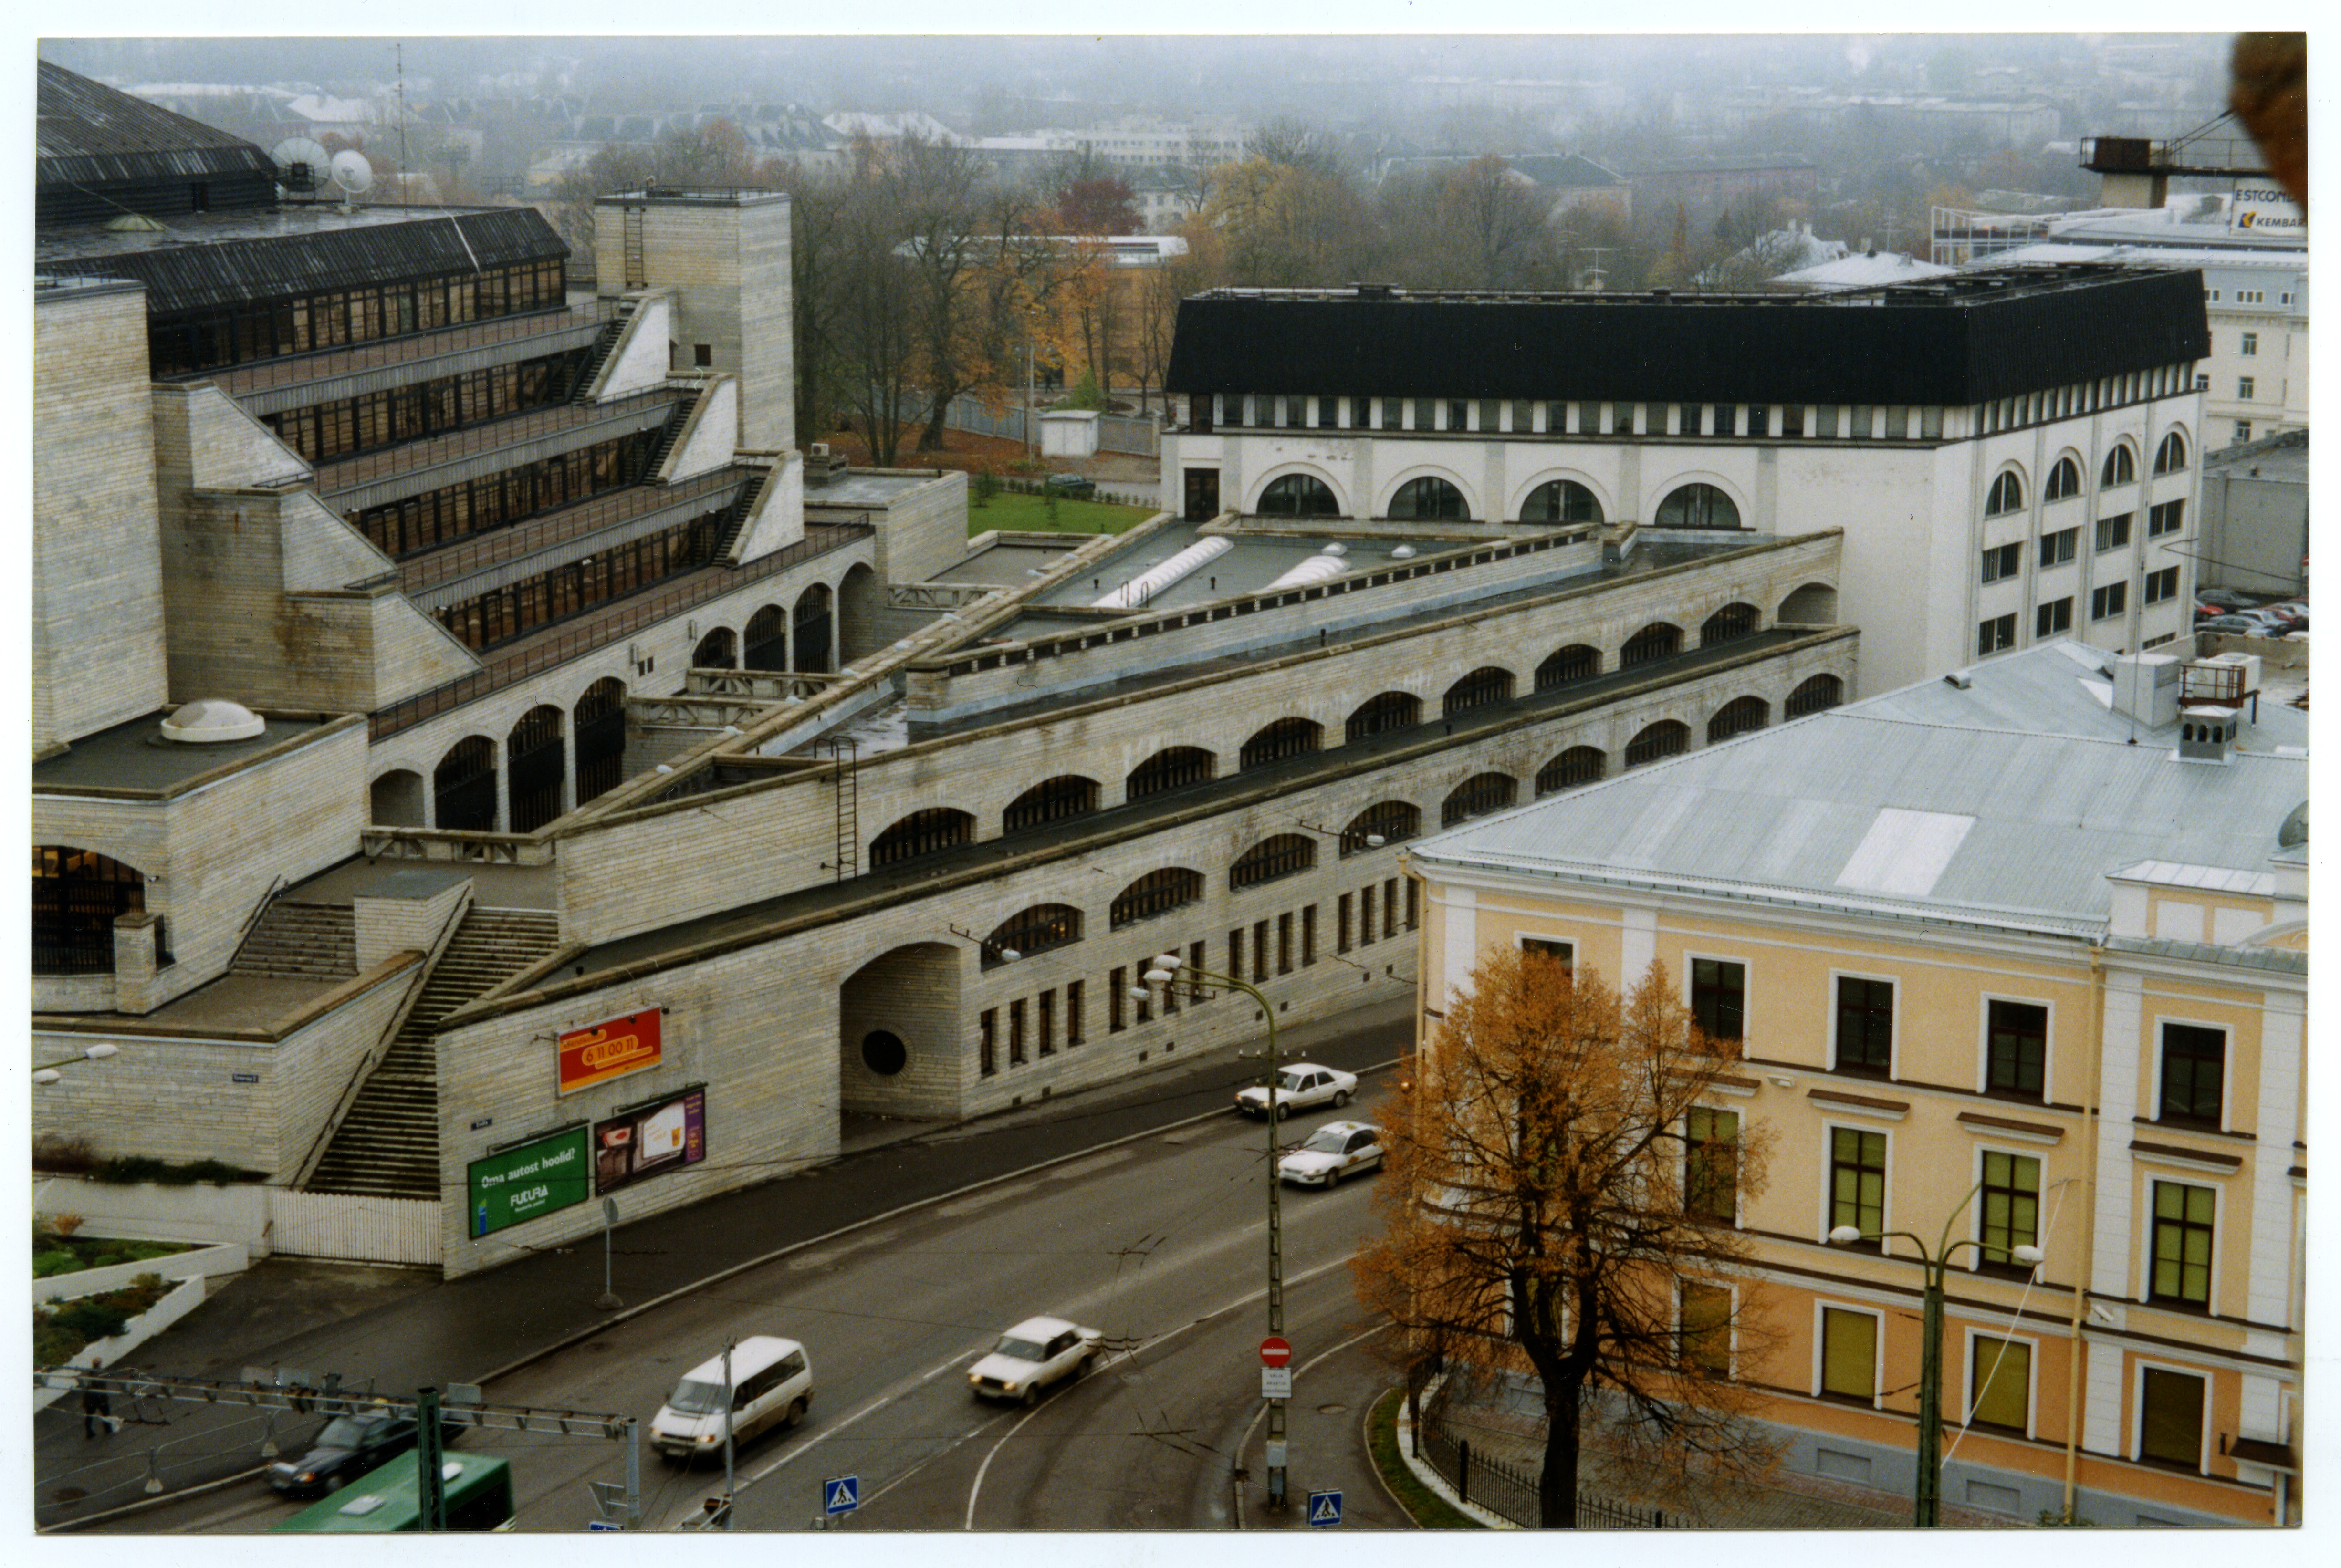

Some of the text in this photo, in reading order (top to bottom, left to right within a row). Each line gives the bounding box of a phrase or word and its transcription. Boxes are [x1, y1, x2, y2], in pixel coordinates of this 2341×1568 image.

[586, 1051, 593, 1062] 6
[597, 1046, 605, 1059] 11
[608, 1041, 623, 1056] 00
[627, 1038, 634, 1050] 11
[482, 1147, 575, 1188] Oma autost hoolid?
[511, 1185, 548, 1207] FUTURA
